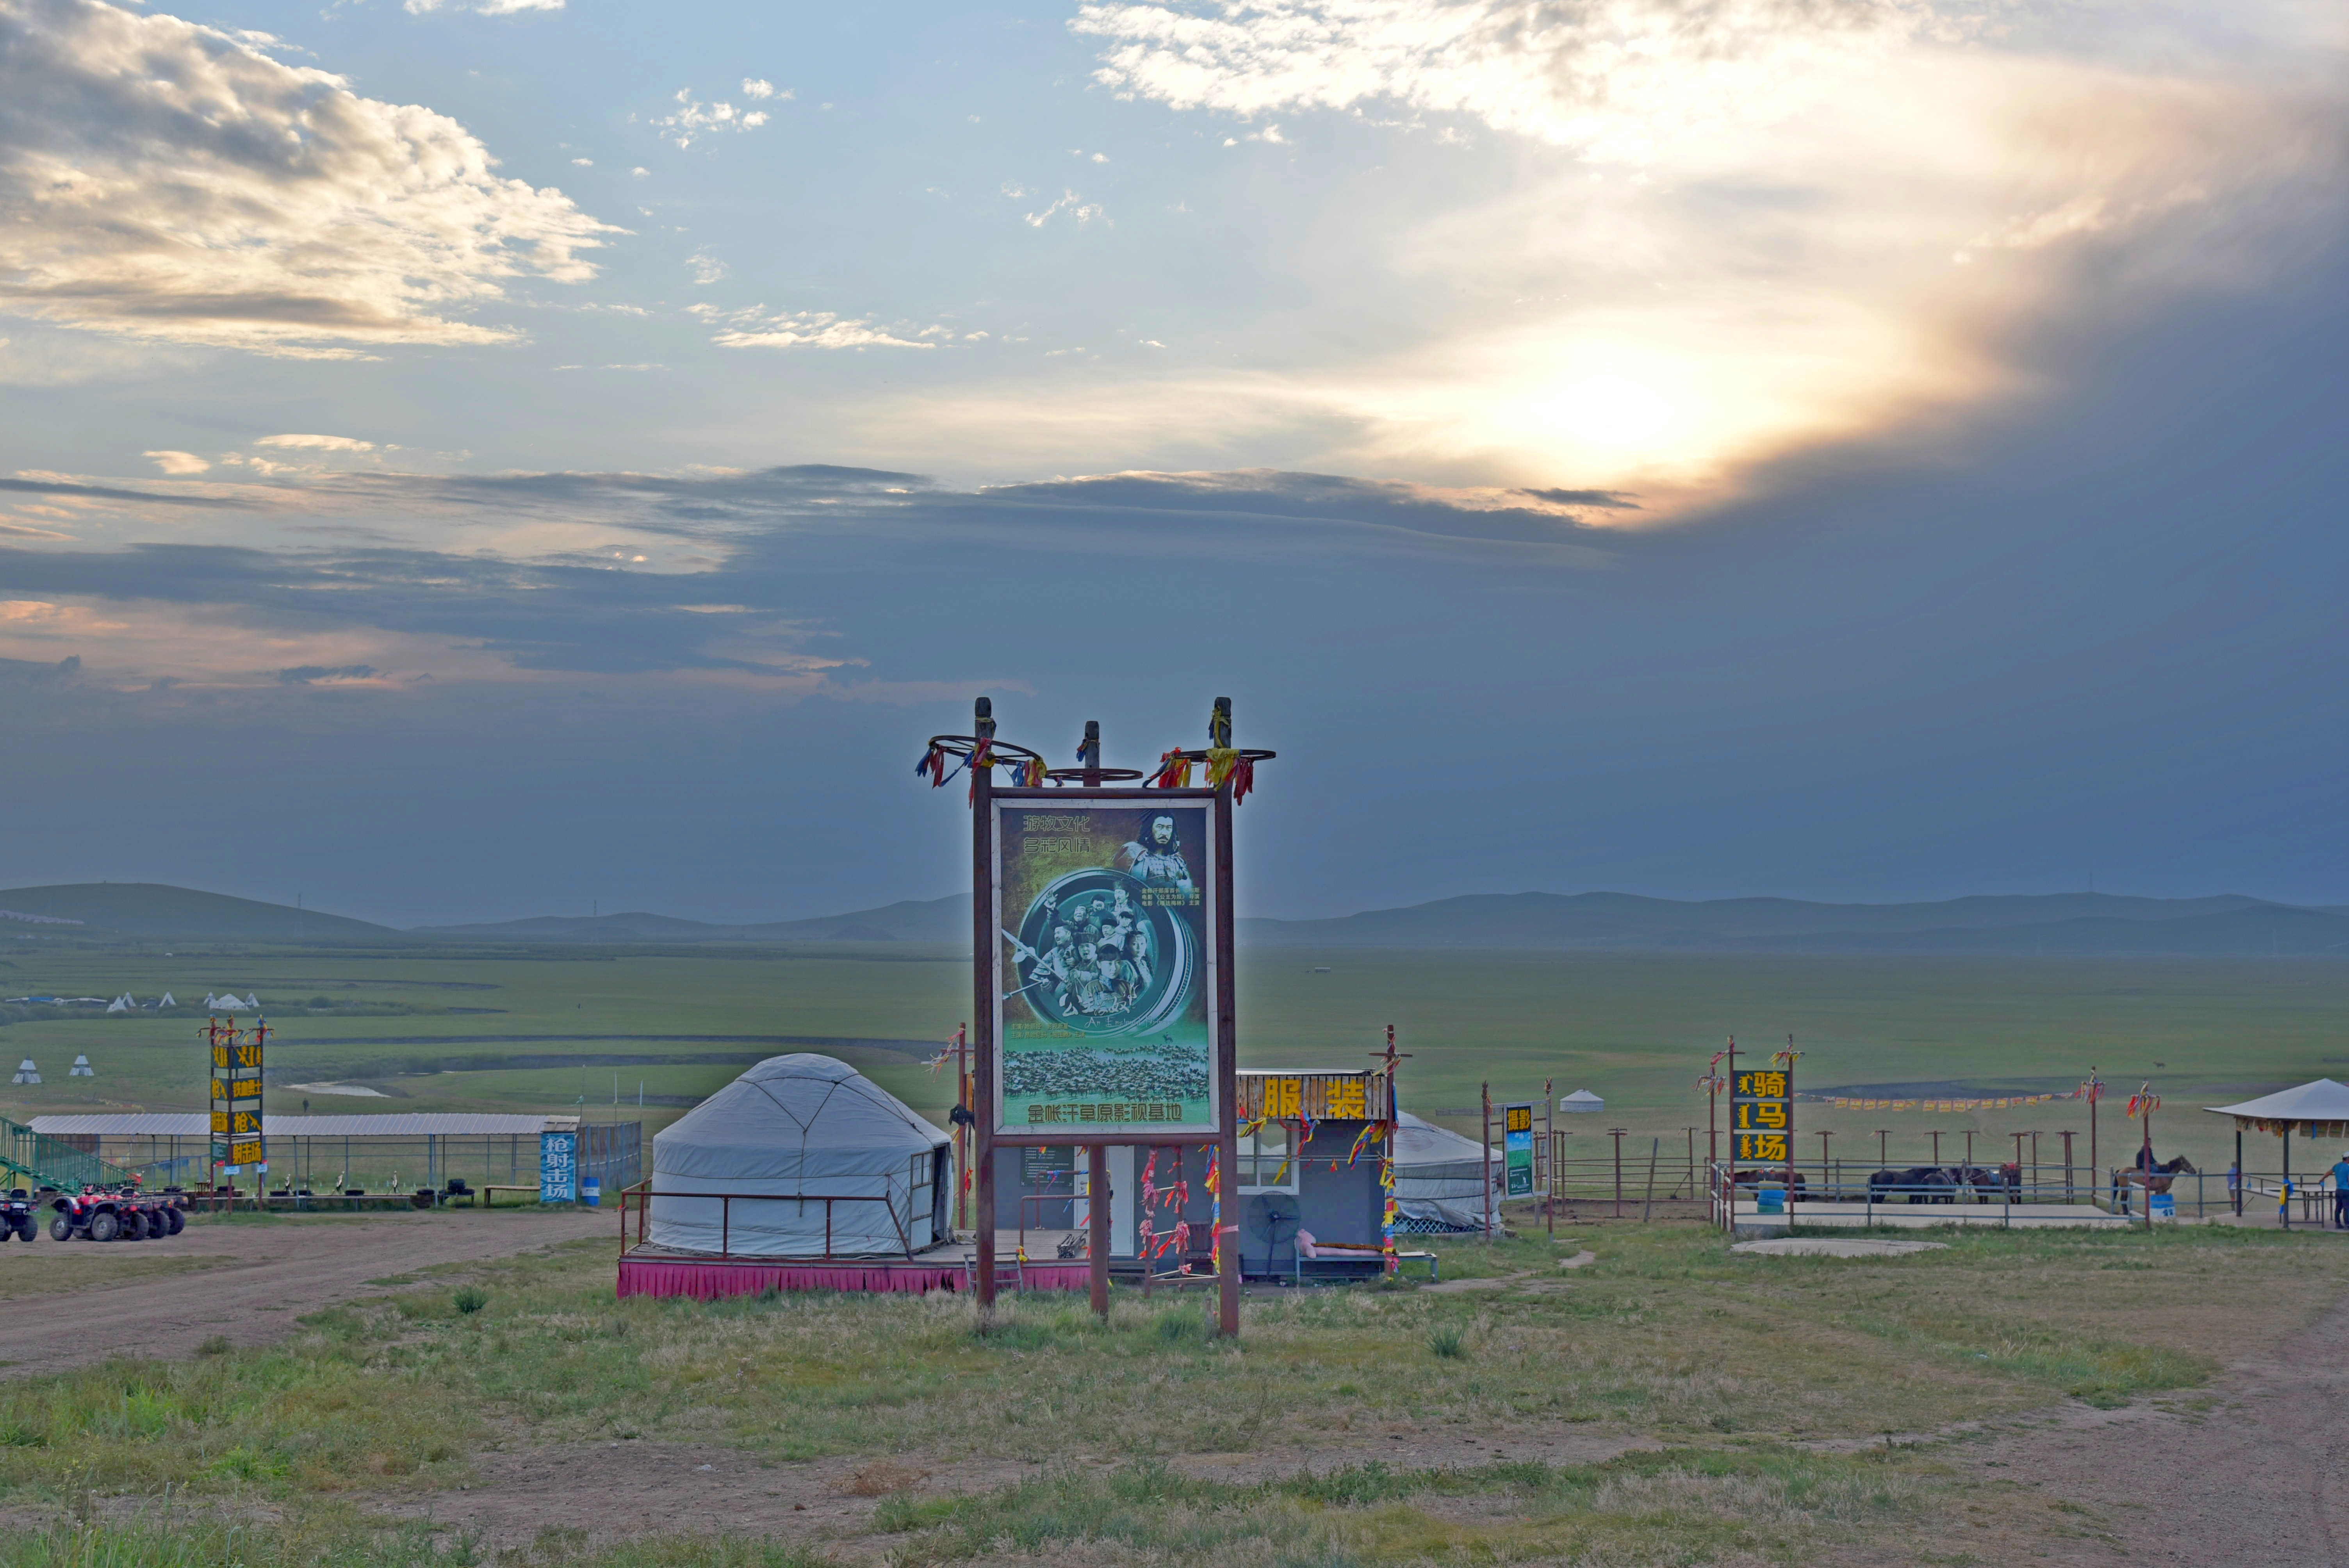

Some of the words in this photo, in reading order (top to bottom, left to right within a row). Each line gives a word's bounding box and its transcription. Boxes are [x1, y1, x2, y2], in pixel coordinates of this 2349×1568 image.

[1023, 815, 1090, 832] 游牧文化
[1023, 837, 1090, 853] 多彩风情
[1084, 1016, 1101, 1028] An
[1263, 1079, 1365, 1119] 服装
[234, 1112, 248, 1133] 枪
[1028, 1104, 1183, 1124] 金帐汗草原影视基地
[1508, 1109, 1530, 1131] 摄影
[1754, 1071, 1787, 1161] 骑马场
[232, 1141, 262, 1165] 射击场
[546, 1138, 569, 1198] 枪射击场
